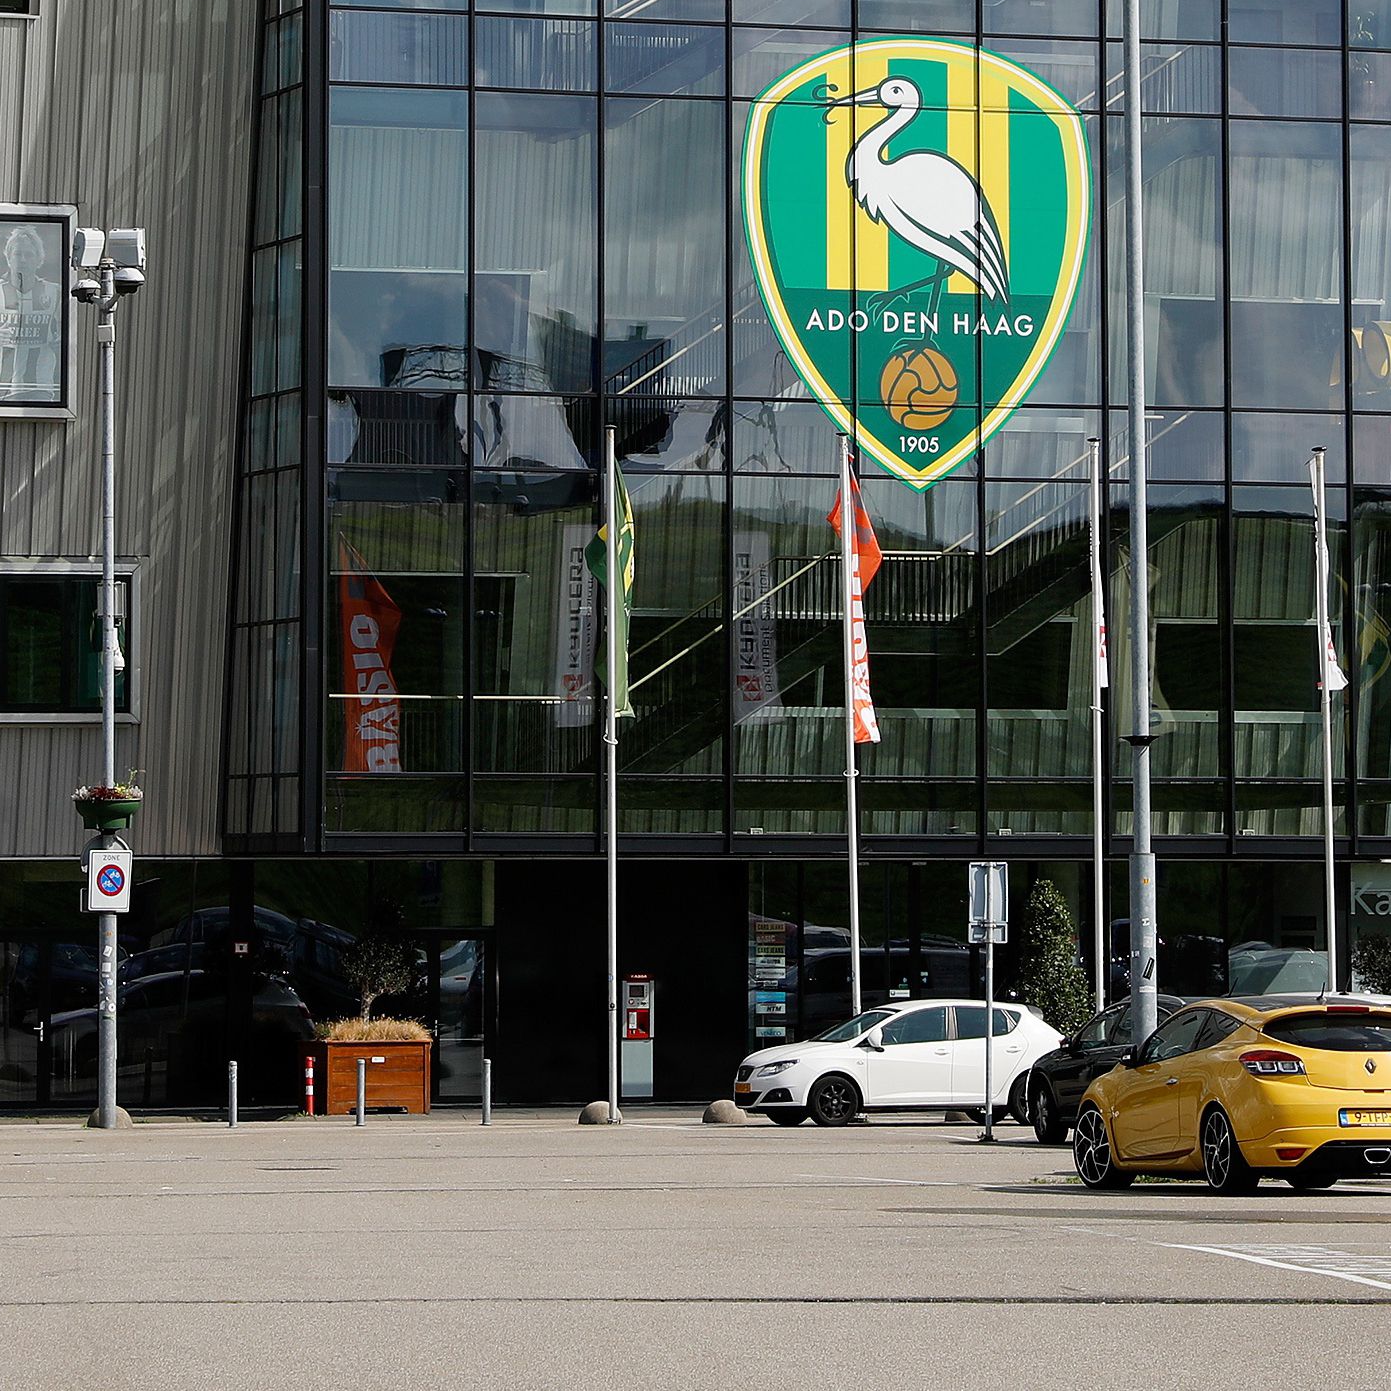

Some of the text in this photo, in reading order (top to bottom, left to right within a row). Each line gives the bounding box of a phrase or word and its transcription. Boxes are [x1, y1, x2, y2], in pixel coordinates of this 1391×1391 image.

[0, 313, 19, 324] FIT
[806, 309, 1034, 336] ADO DEN HAAG
[899, 436, 940, 454] 1905
